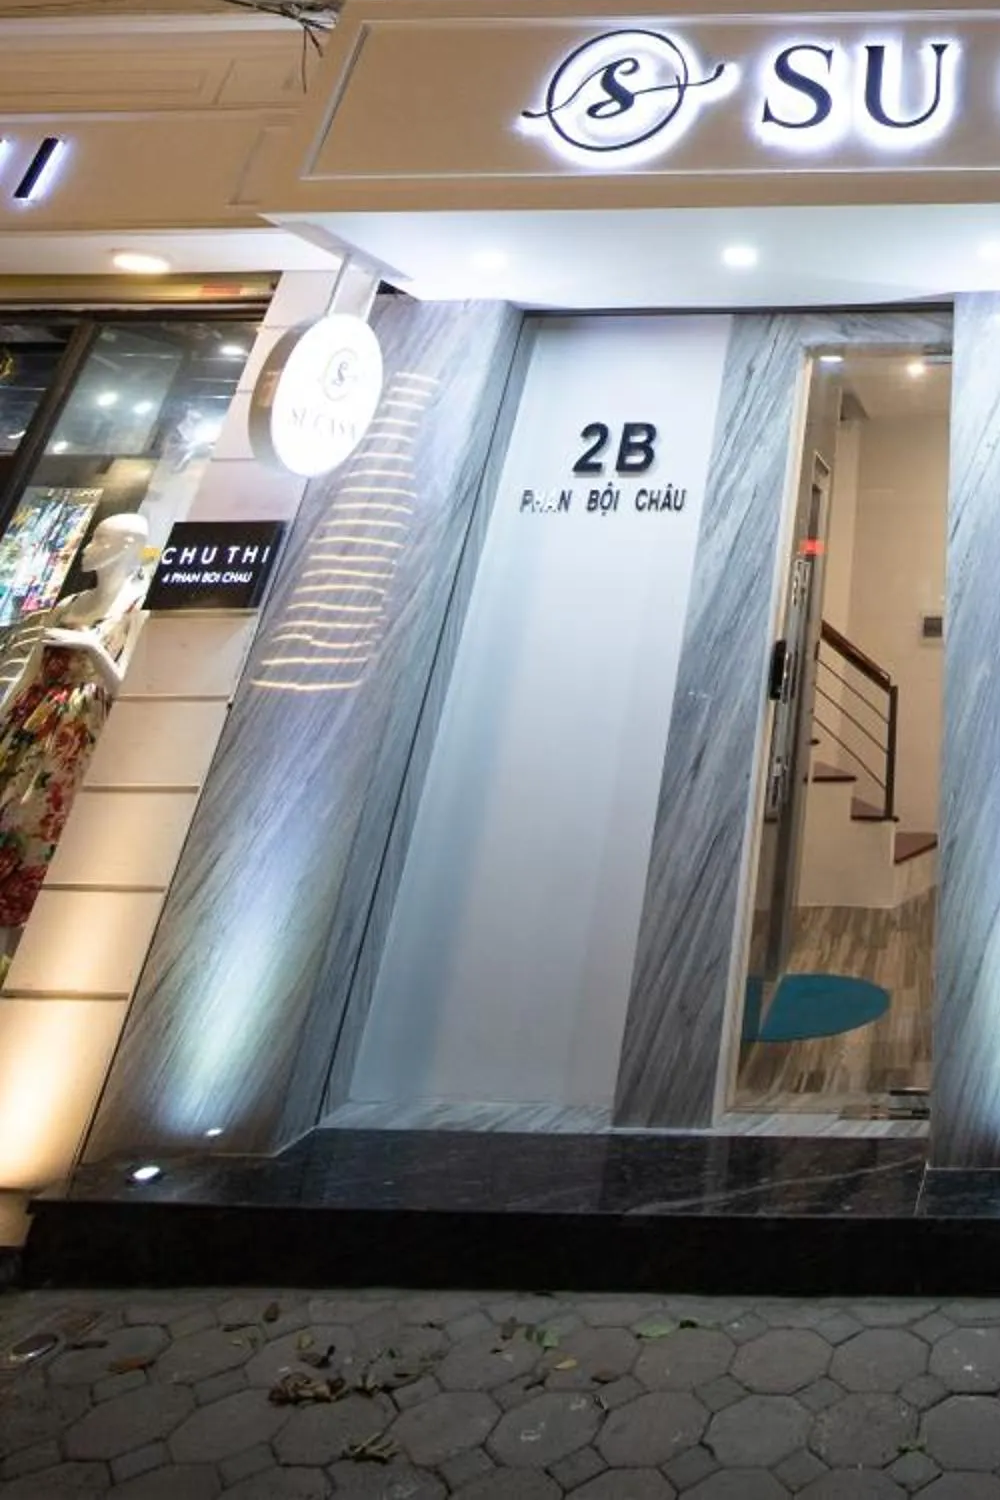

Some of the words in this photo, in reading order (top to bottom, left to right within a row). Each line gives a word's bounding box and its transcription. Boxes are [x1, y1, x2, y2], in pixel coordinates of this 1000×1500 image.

[760, 41, 949, 130] SU
[572, 421, 658, 474] 2B
[634, 482, 688, 512] CHÂU
[161, 546, 218, 565] CHU
[227, 545, 272, 564] THI
